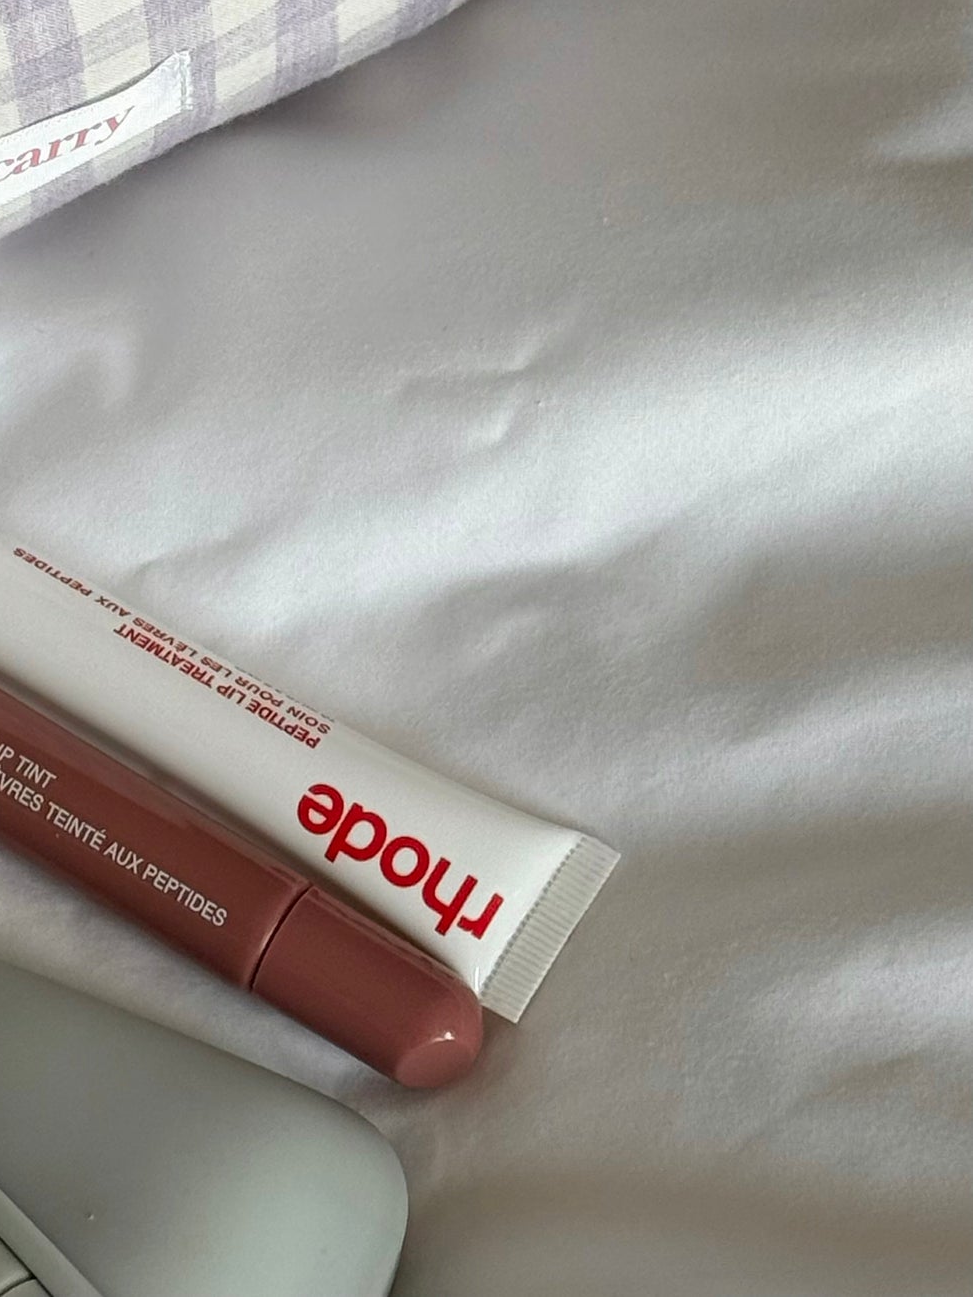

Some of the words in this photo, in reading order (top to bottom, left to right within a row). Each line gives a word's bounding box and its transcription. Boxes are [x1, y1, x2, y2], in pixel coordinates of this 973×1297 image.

[13, 546, 93, 597] PEPTIDES
[95, 595, 131, 617] AUX
[113, 623, 214, 690] TREATMENT
[200, 655, 232, 678] LES
[216, 683, 247, 705] LIP
[234, 674, 284, 708] POUR
[246, 697, 321, 749] PEPTIDE
[285, 705, 332, 735] SOIN
[18, 754, 57, 790] TINT
[45, 801, 108, 852] TEINTÉ
[104, 842, 144, 875] AUX
[142, 863, 228, 927] PEPTIDES
[296, 782, 504, 941] rhode
